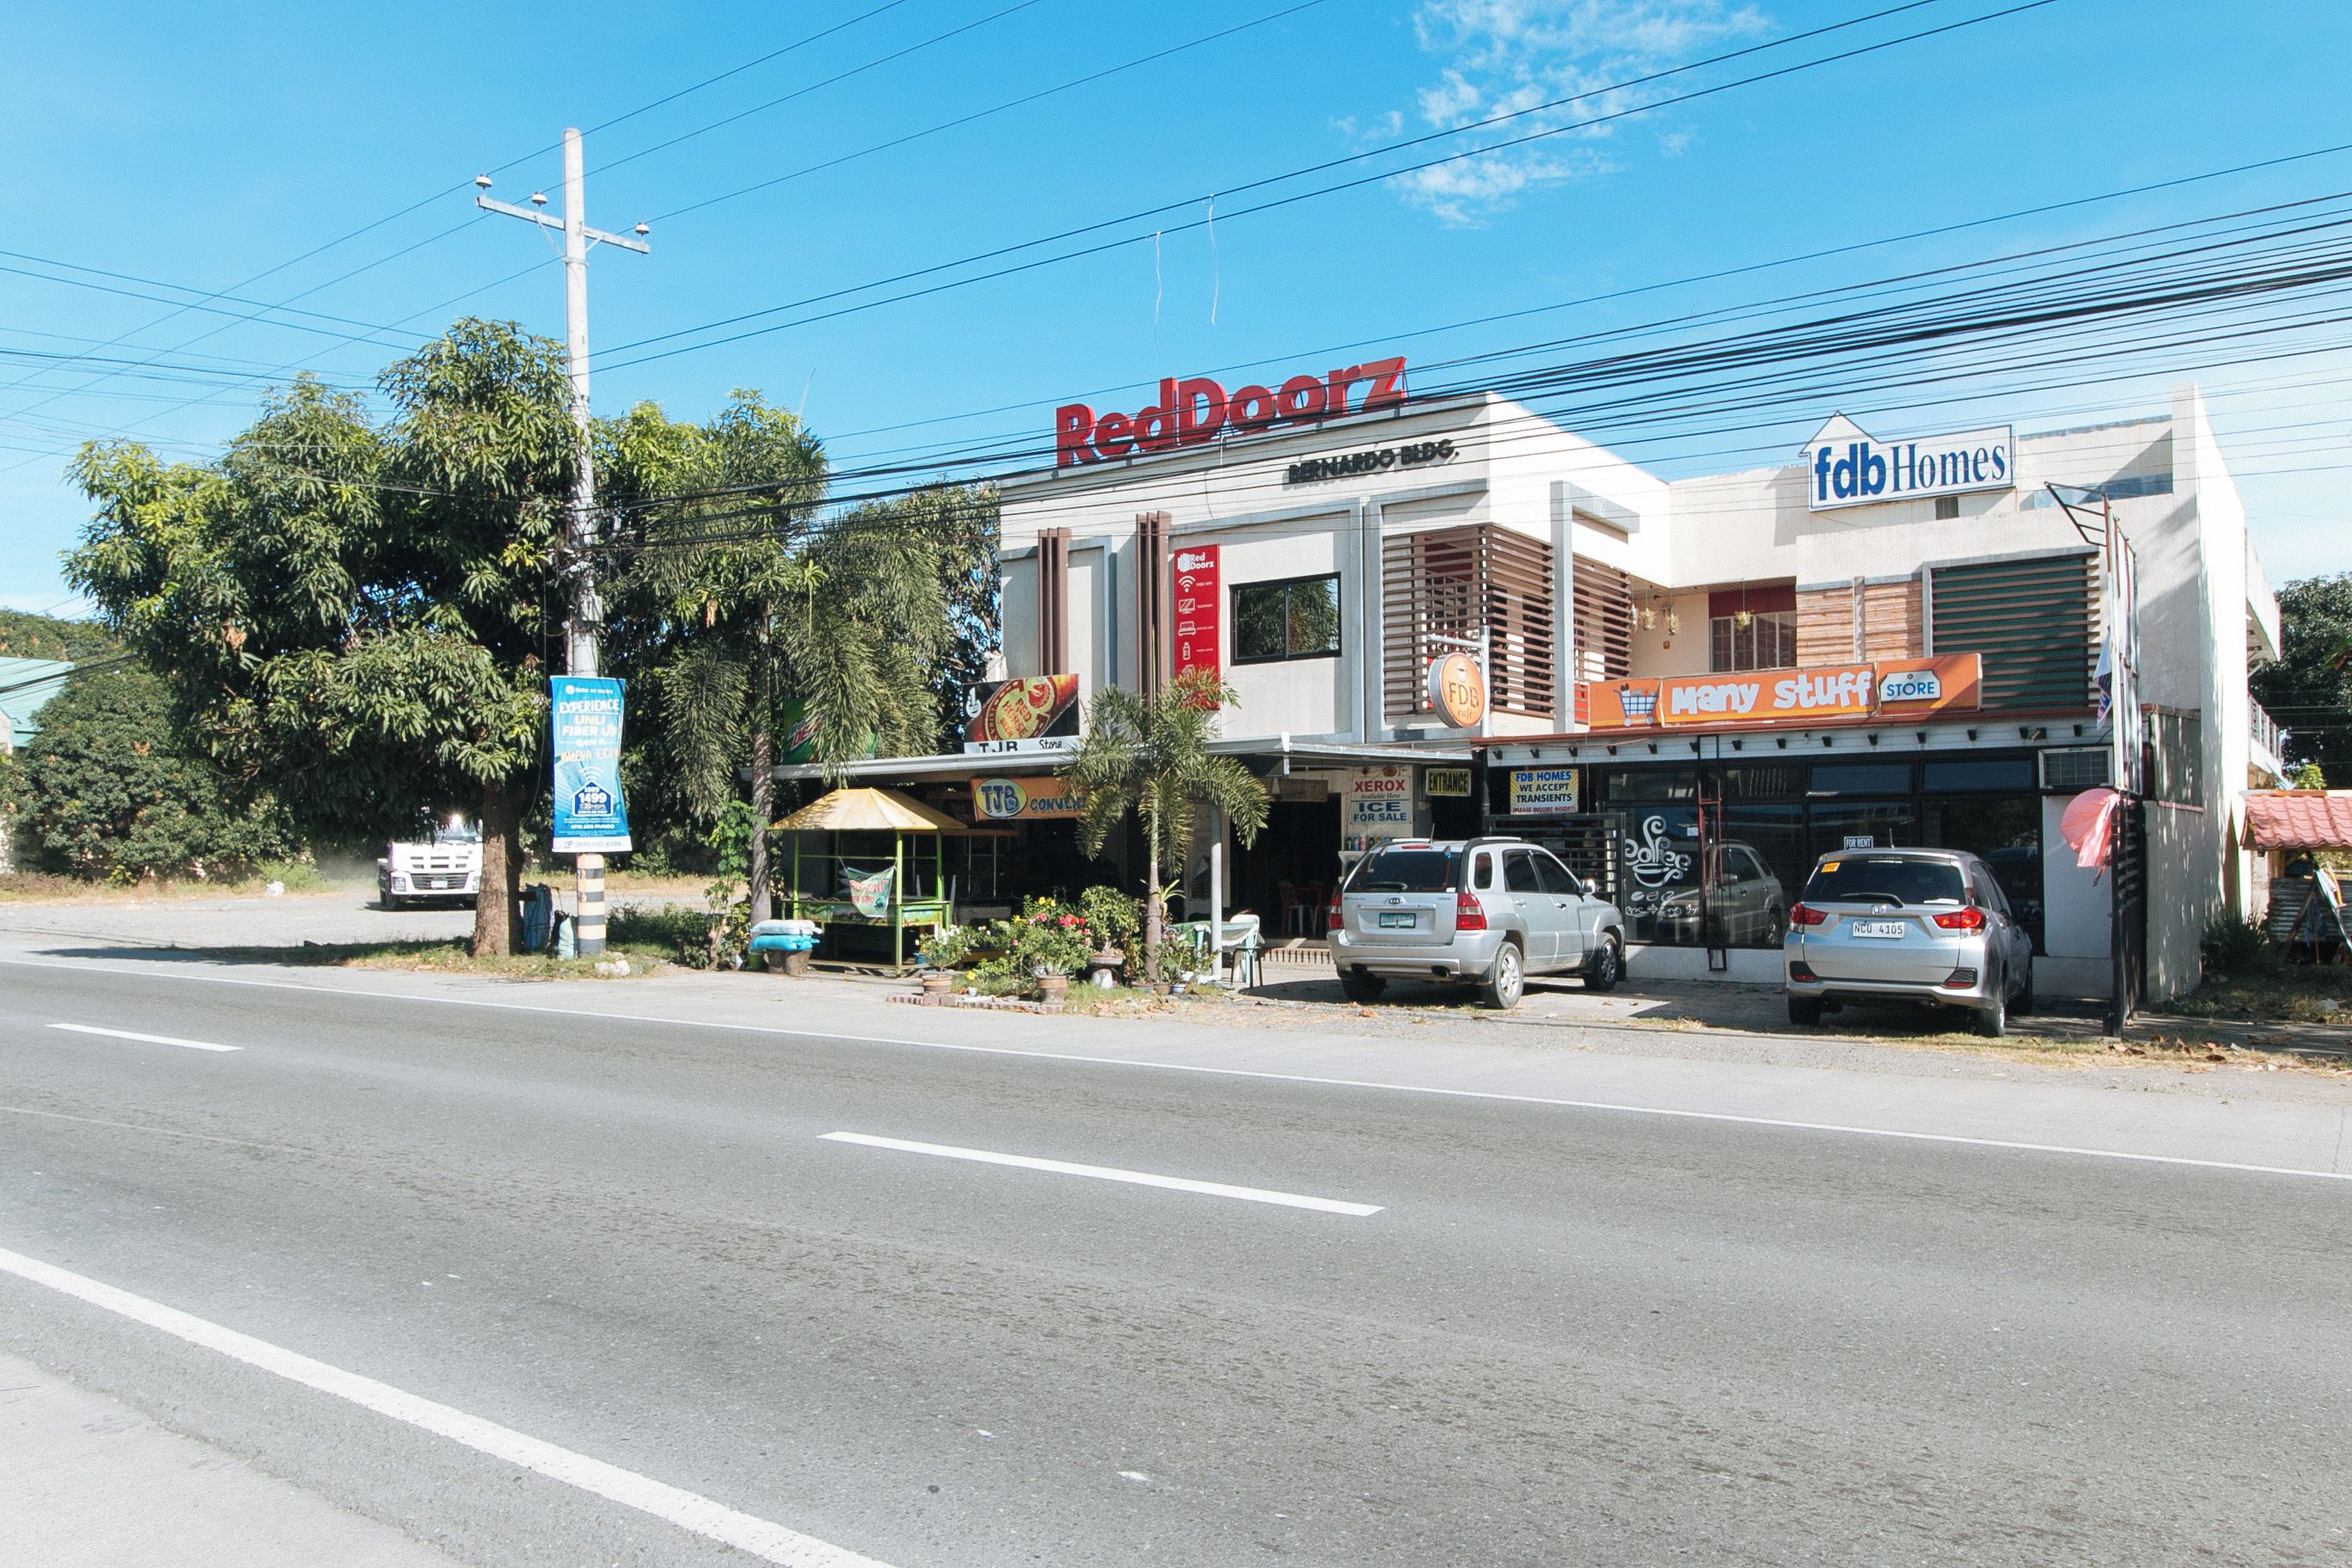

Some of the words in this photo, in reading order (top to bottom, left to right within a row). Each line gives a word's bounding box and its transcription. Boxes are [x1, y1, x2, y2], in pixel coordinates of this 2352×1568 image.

[1056, 356, 1407, 468] RedDoorz
[1289, 448, 1396, 485] BERNARDO
[1815, 442, 1886, 501] fdb
[1890, 443, 2006, 493] Homes
[1190, 552, 1205, 562] Red
[1449, 681, 1479, 707] FDB
[1886, 681, 1935, 697] STORE
[1671, 683, 1760, 715] Many
[560, 699, 620, 714] EXPERIENCE
[1015, 698, 1032, 722] RED
[562, 725, 598, 736] FIBER
[1038, 739, 1063, 750] Store
[1516, 773, 1534, 782] FDB
[1537, 771, 1571, 781] HOMES
[1355, 780, 1405, 792] XEROX
[1430, 774, 1468, 792] ENTRANCE
[579, 793, 607, 803] 1499
[981, 785, 1020, 814] TJB
[1516, 793, 1572, 802] TRANSIENTS
[1359, 802, 1400, 812] ICE
[1353, 813, 1375, 822] FOR
[1379, 812, 1406, 821] SALE
[1846, 838, 1856, 848] FOR
[1857, 838, 1871, 848] RENT
[1854, 923, 1872, 933] NCU
[1879, 923, 1902, 934] 4105
